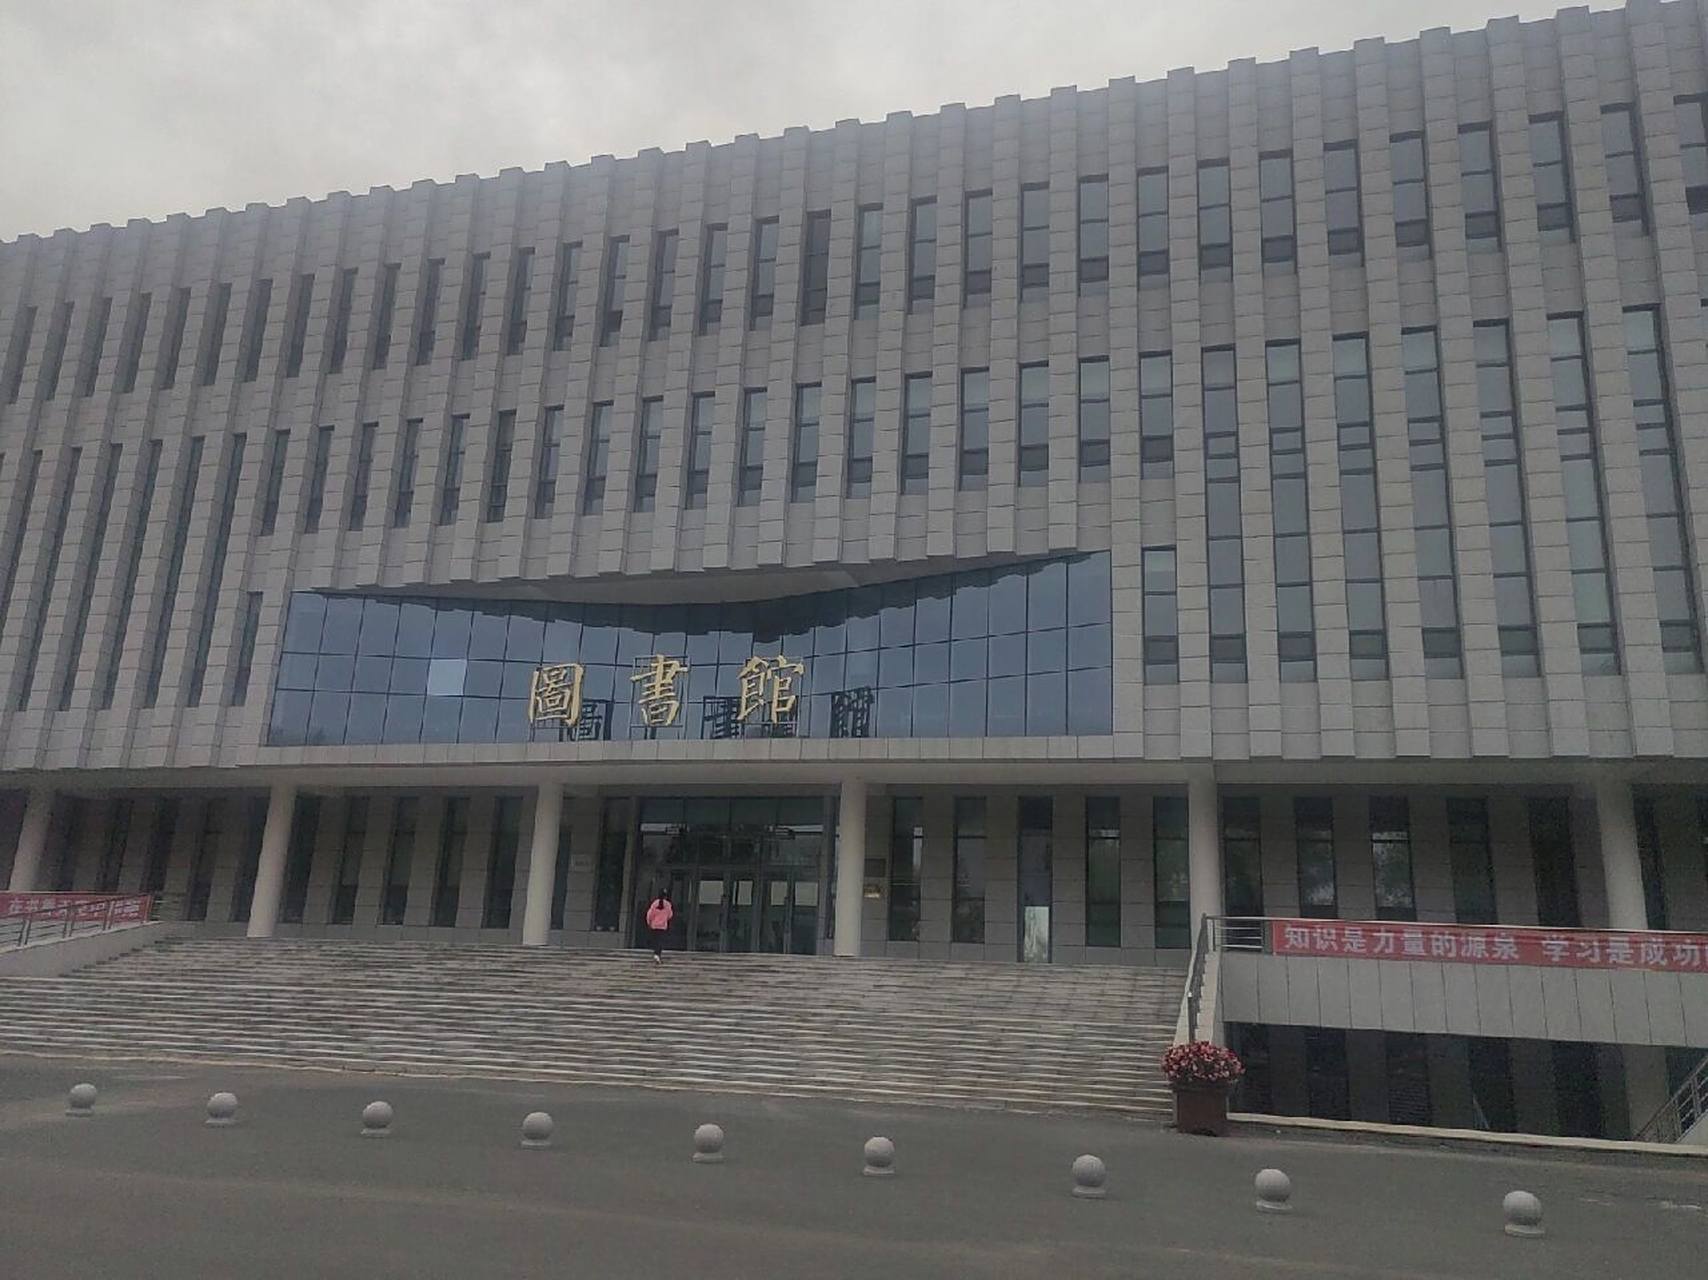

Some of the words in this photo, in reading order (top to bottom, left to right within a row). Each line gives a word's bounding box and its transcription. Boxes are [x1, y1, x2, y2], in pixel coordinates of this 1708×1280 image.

[528, 654, 804, 726] 圖書館
[1284, 924, 1520, 960] 知识是力量的源泉
[1541, 934, 1708, 967] 学习是成功
